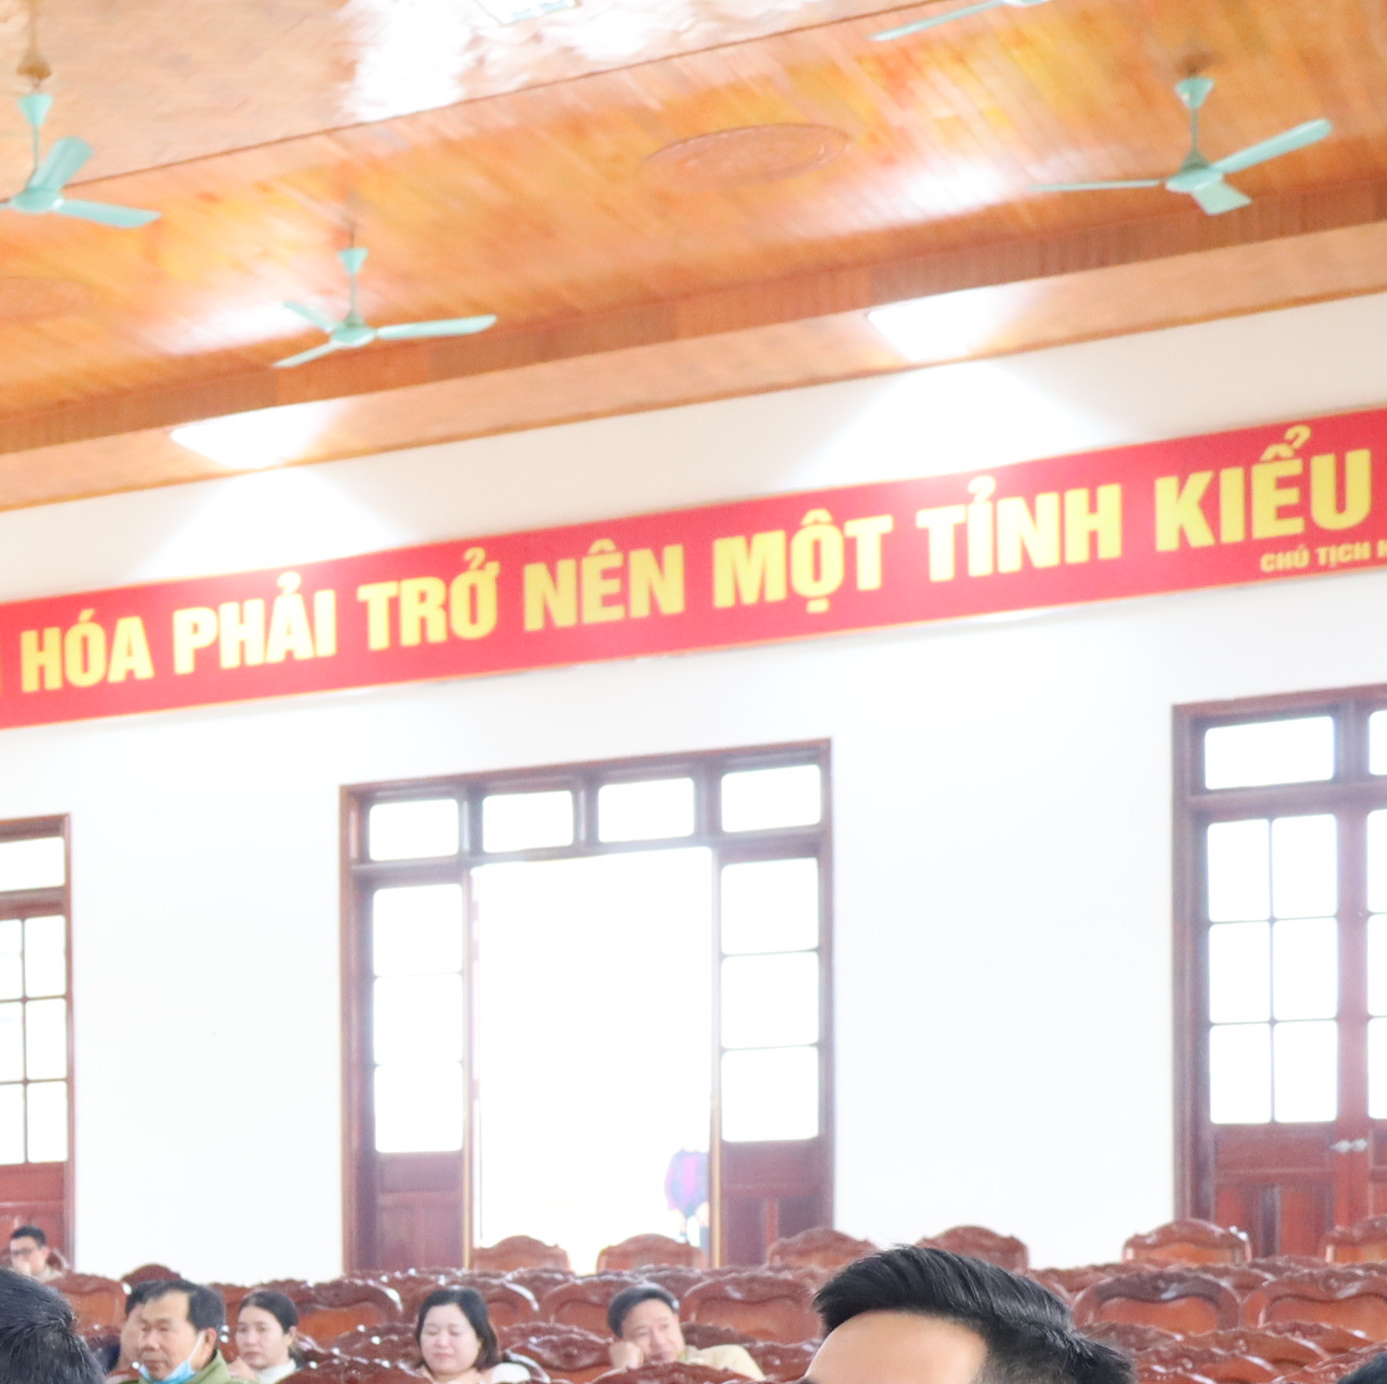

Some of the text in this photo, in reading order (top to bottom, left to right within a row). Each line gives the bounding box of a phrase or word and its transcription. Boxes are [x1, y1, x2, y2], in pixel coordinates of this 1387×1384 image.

[20, 608, 156, 693] HÓA
[172, 570, 339, 676] PHẢI
[355, 546, 501, 652] TRỞ
[524, 538, 686, 632] NÊN
[712, 507, 896, 615] MỘT
[916, 475, 1125, 583] TỈNH
[1154, 425, 1372, 553] KIỂU
